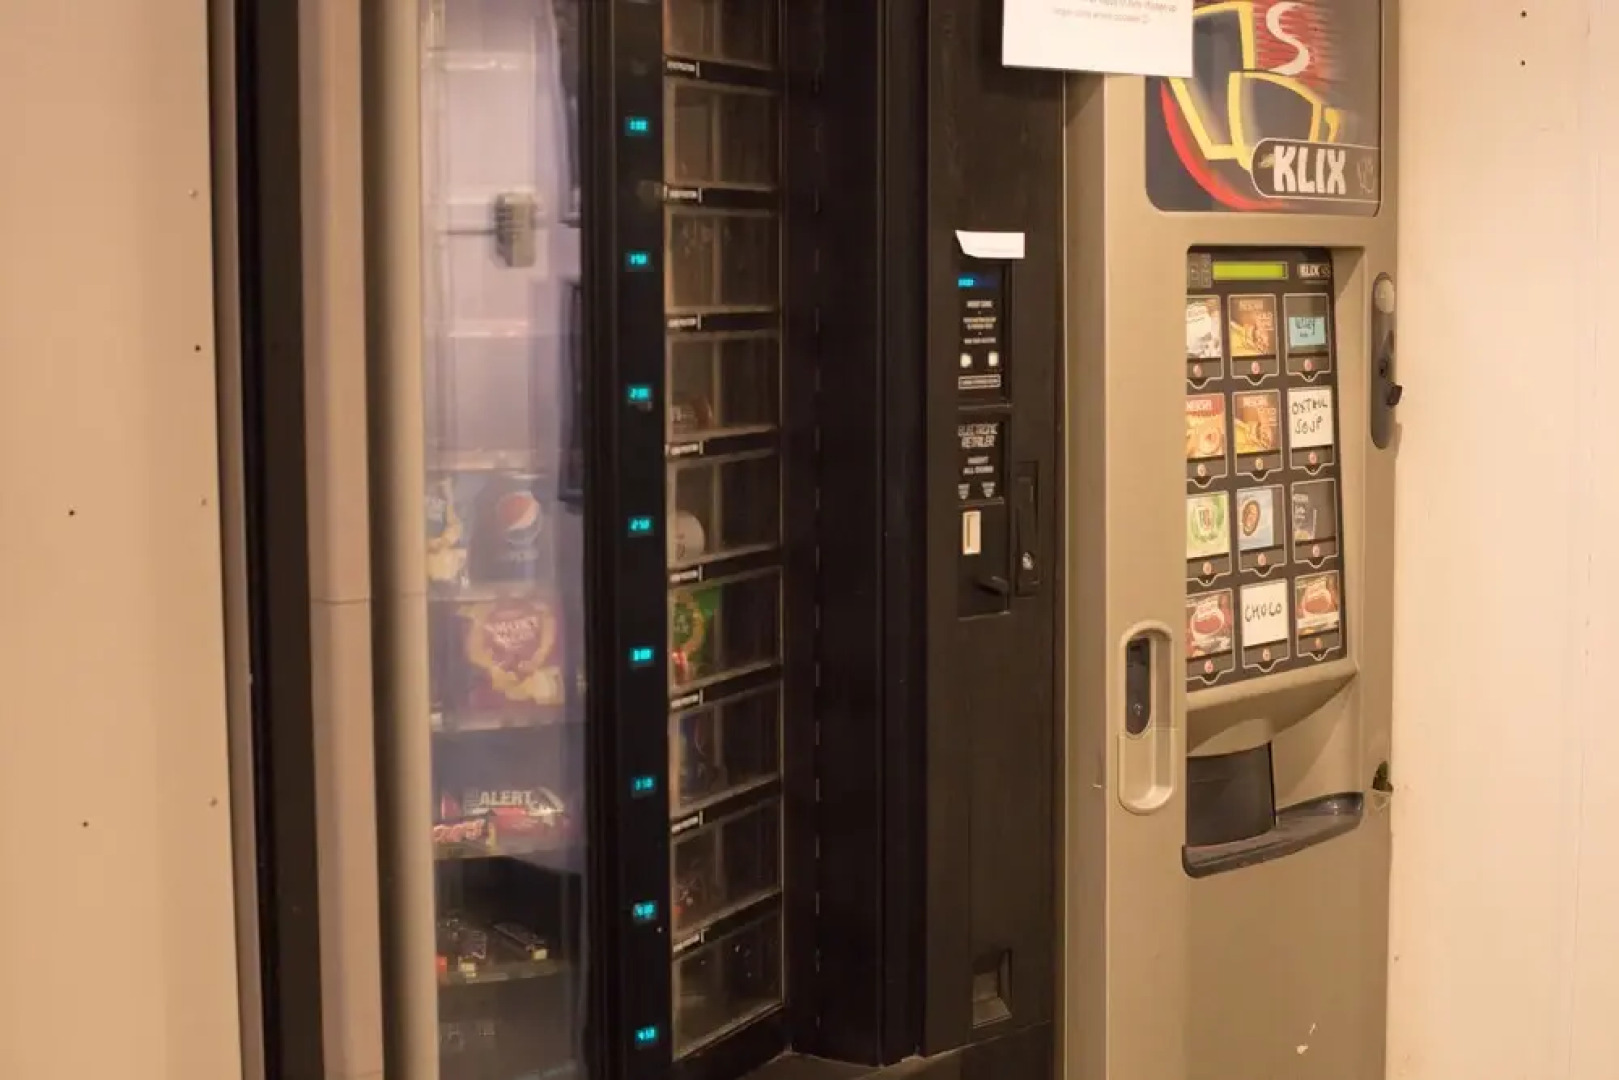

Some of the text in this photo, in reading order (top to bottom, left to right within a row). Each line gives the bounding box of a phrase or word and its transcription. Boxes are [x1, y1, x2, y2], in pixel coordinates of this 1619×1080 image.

[1273, 145, 1346, 195] KLIX
[1295, 416, 1323, 434] SOUP
[1244, 601, 1282, 622] CHOCO
[479, 790, 532, 806] ALERT
